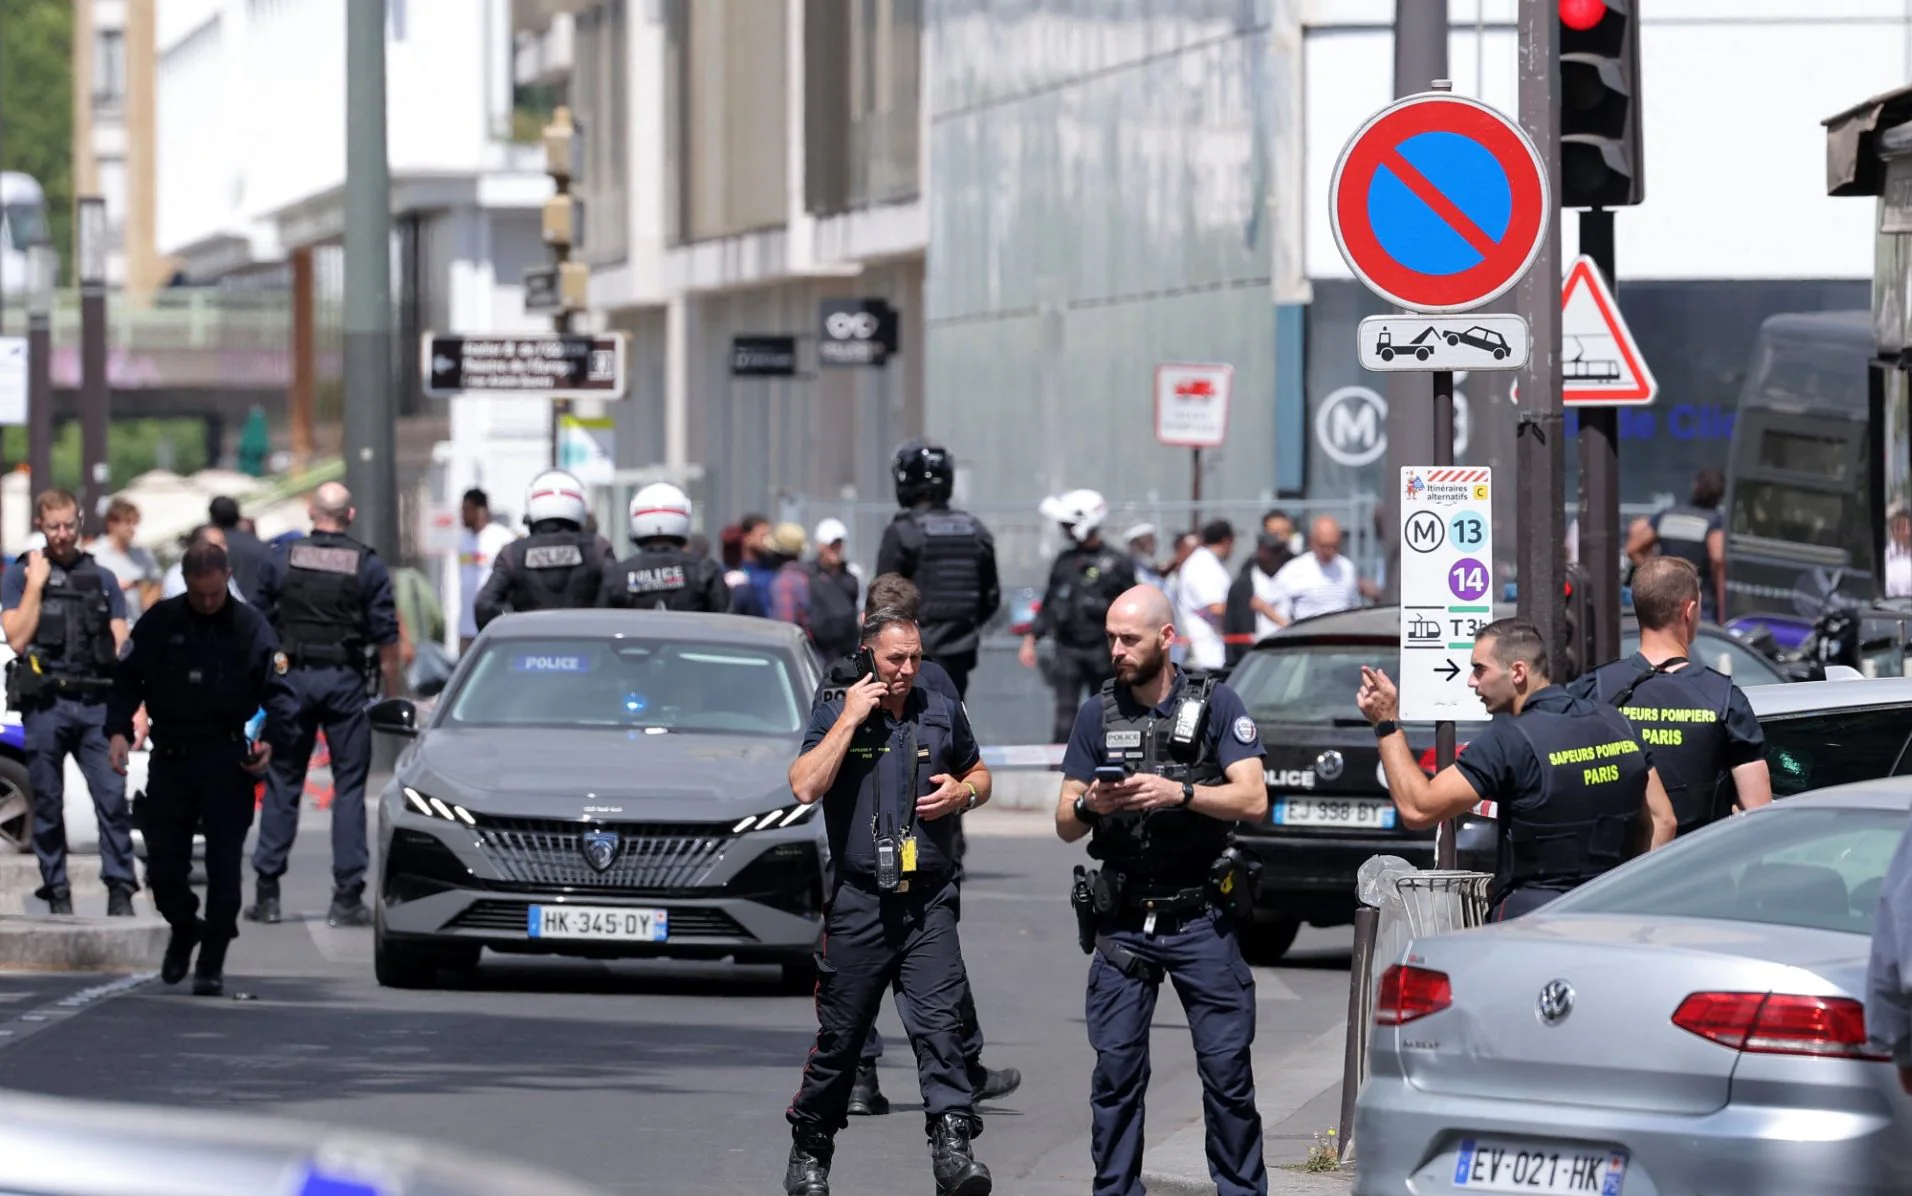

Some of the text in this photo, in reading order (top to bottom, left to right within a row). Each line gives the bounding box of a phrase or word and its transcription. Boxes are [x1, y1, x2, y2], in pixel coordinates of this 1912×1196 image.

[1427, 484, 1468, 492] Itinéraires
[1427, 493, 1468, 501] alternatifs
[1476, 487, 1484, 497] C
[1414, 520, 1436, 544] M
[1453, 519, 1483, 544] 13
[1452, 567, 1485, 592] 14
[526, 656, 578, 669] POLICE
[1661, 708, 1717, 722] POMPIERS
[1108, 733, 1138, 741] POLICE
[1642, 728, 1683, 745] PARIS
[1549, 746, 1595, 766] SAPEURS
[1583, 764, 1620, 786] PARIS
[544, 911, 650, 935] HK-345-DY
[1472, 1148, 1603, 1191] EV-021-HK
